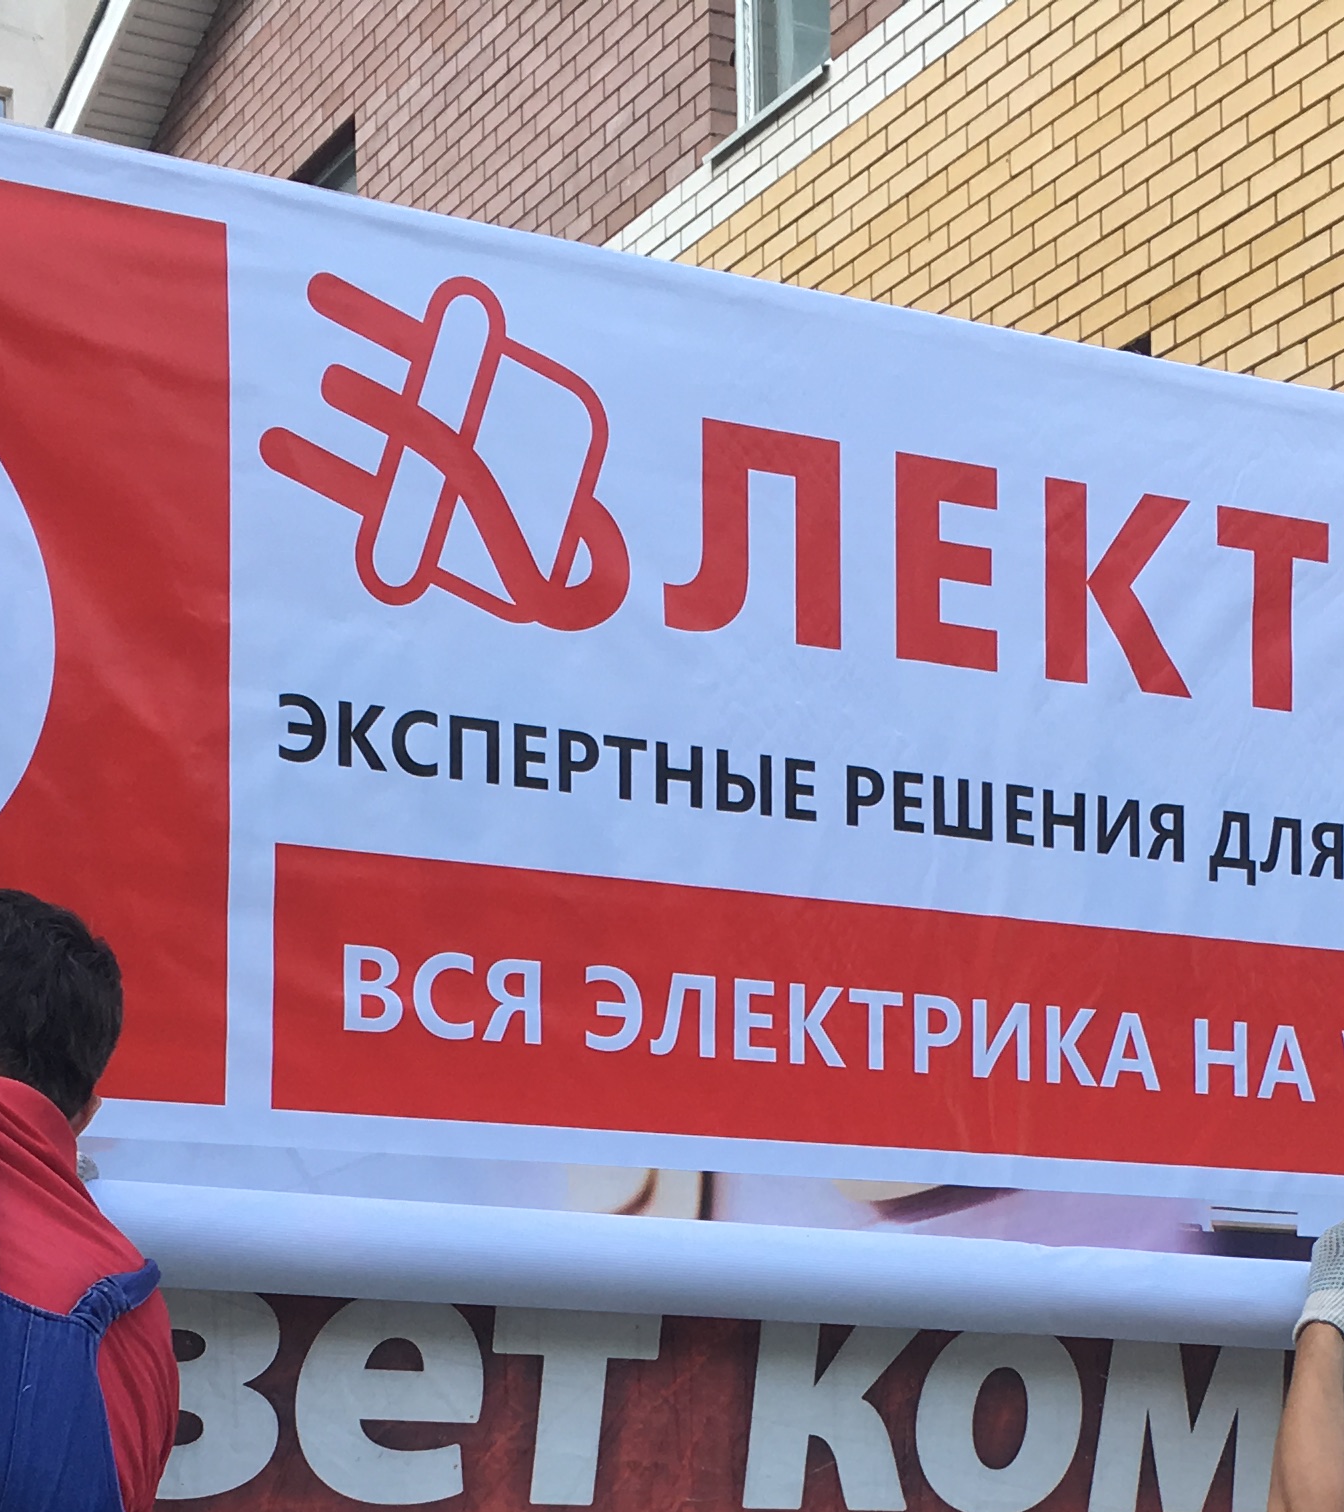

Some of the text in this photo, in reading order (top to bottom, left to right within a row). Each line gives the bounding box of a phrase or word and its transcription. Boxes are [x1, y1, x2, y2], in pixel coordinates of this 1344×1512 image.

[278, 693, 817, 822] ЭКСПЕРТНЫЕ
[846, 765, 1185, 863] РЕШЕНИЯ
[1208, 810, 1344, 886] ДЛЯ
[343, 943, 542, 1046] ВСЯ
[584, 964, 1161, 1092] ЭЛЕКТРИКА
[1193, 1017, 1316, 1103] НА
